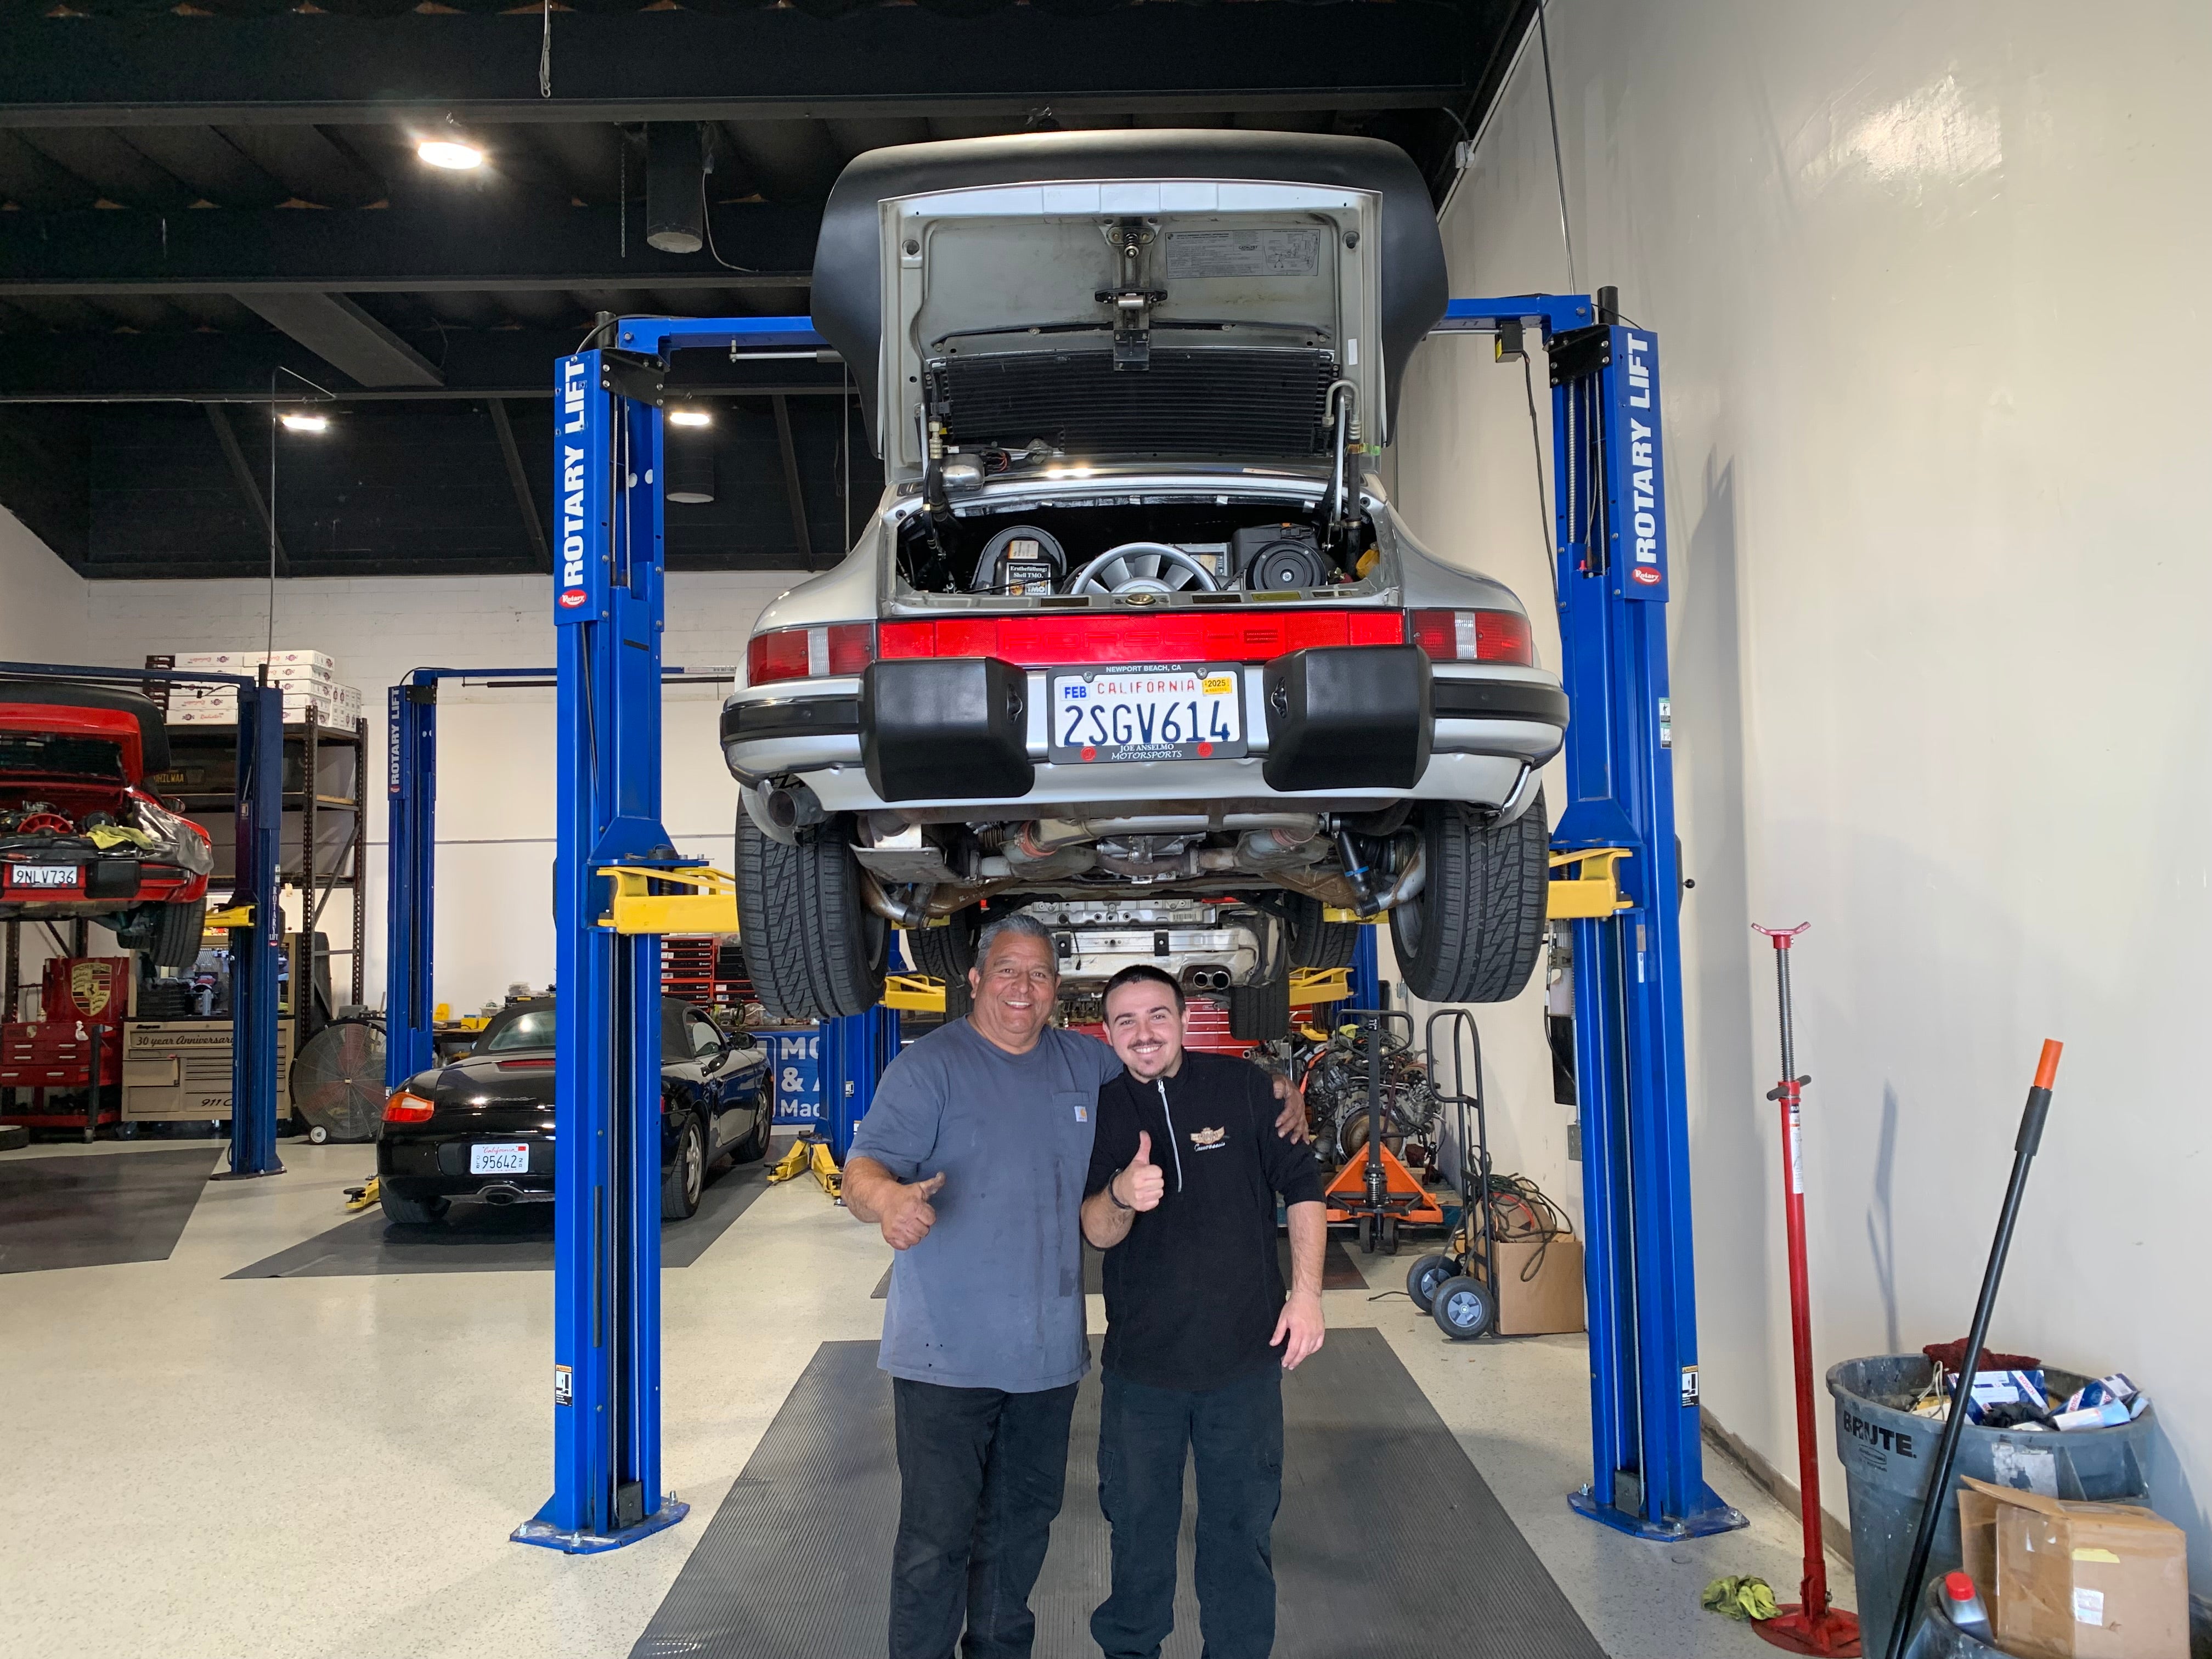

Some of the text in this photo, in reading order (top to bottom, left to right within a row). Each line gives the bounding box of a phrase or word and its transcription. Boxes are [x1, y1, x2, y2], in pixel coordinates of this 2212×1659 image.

[1628, 332, 1656, 563] ROTARY LIFT
[564, 361, 585, 587] ROTARY LIFT
[1634, 569, 1659, 582] Rotary
[562, 595, 584, 605] Rotary
[1064, 686, 1087, 699] FEB
[1098, 680, 1195, 695] CALIFORNIA
[391, 688, 400, 720] LIFT
[1064, 699, 1231, 747] 2SGV614
[391, 724, 399, 785] ROTARY
[1111, 749, 1182, 760] MOTORSPORTS
[1119, 743, 1175, 754] JOE ANSELMO
[16, 870, 74, 883] 9NLV736
[136, 1036, 149, 1046] 30
[151, 1037, 174, 1047] year
[781, 1066, 805, 1092] &
[201, 1098, 221, 1107] 911
[483, 1146, 518, 1155] California
[482, 1155, 517, 1169] 95642
[2018, 1375, 2035, 1395] BOSCH
